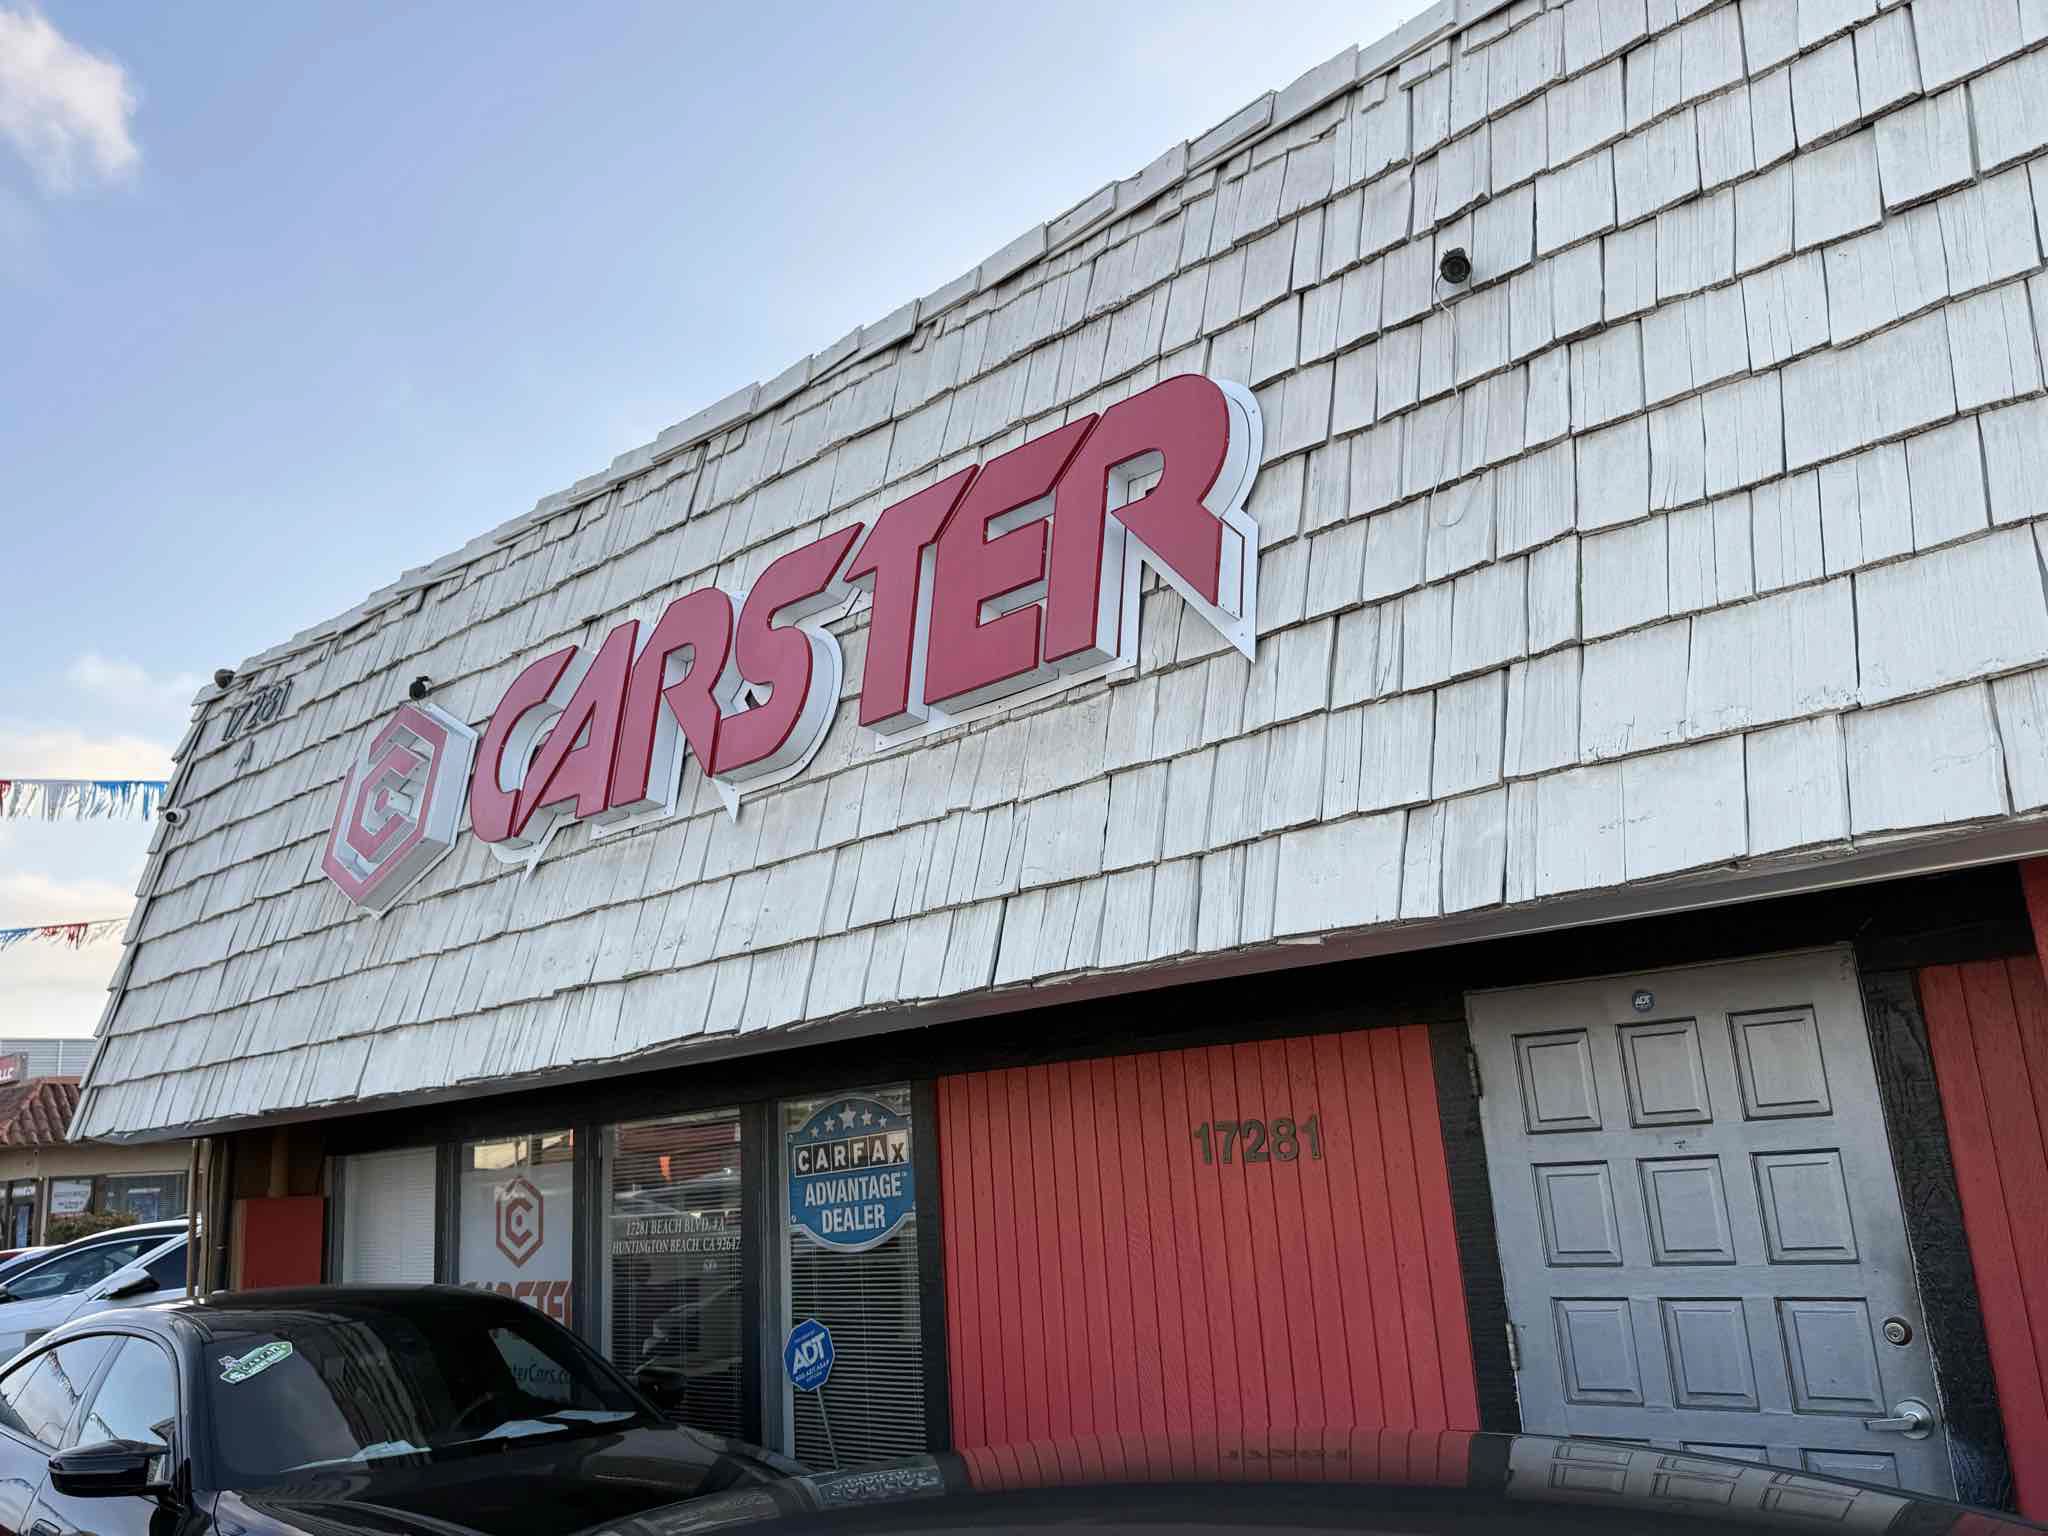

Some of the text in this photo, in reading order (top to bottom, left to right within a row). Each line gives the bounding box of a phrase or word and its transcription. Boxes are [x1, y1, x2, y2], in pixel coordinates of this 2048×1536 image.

[470, 373, 1262, 850] CARSTER
[797, 1136, 906, 1173] CARFAX
[1194, 1113, 1321, 1165] 17281
[804, 1172, 902, 1207] ADVANTAGE
[651, 1218, 682, 1234] BEACH
[821, 1204, 886, 1233] DEALER
[611, 1239, 669, 1255] HUNTINGTON
[703, 1237, 716, 1251] CA
[792, 1332, 826, 1375] ADT
